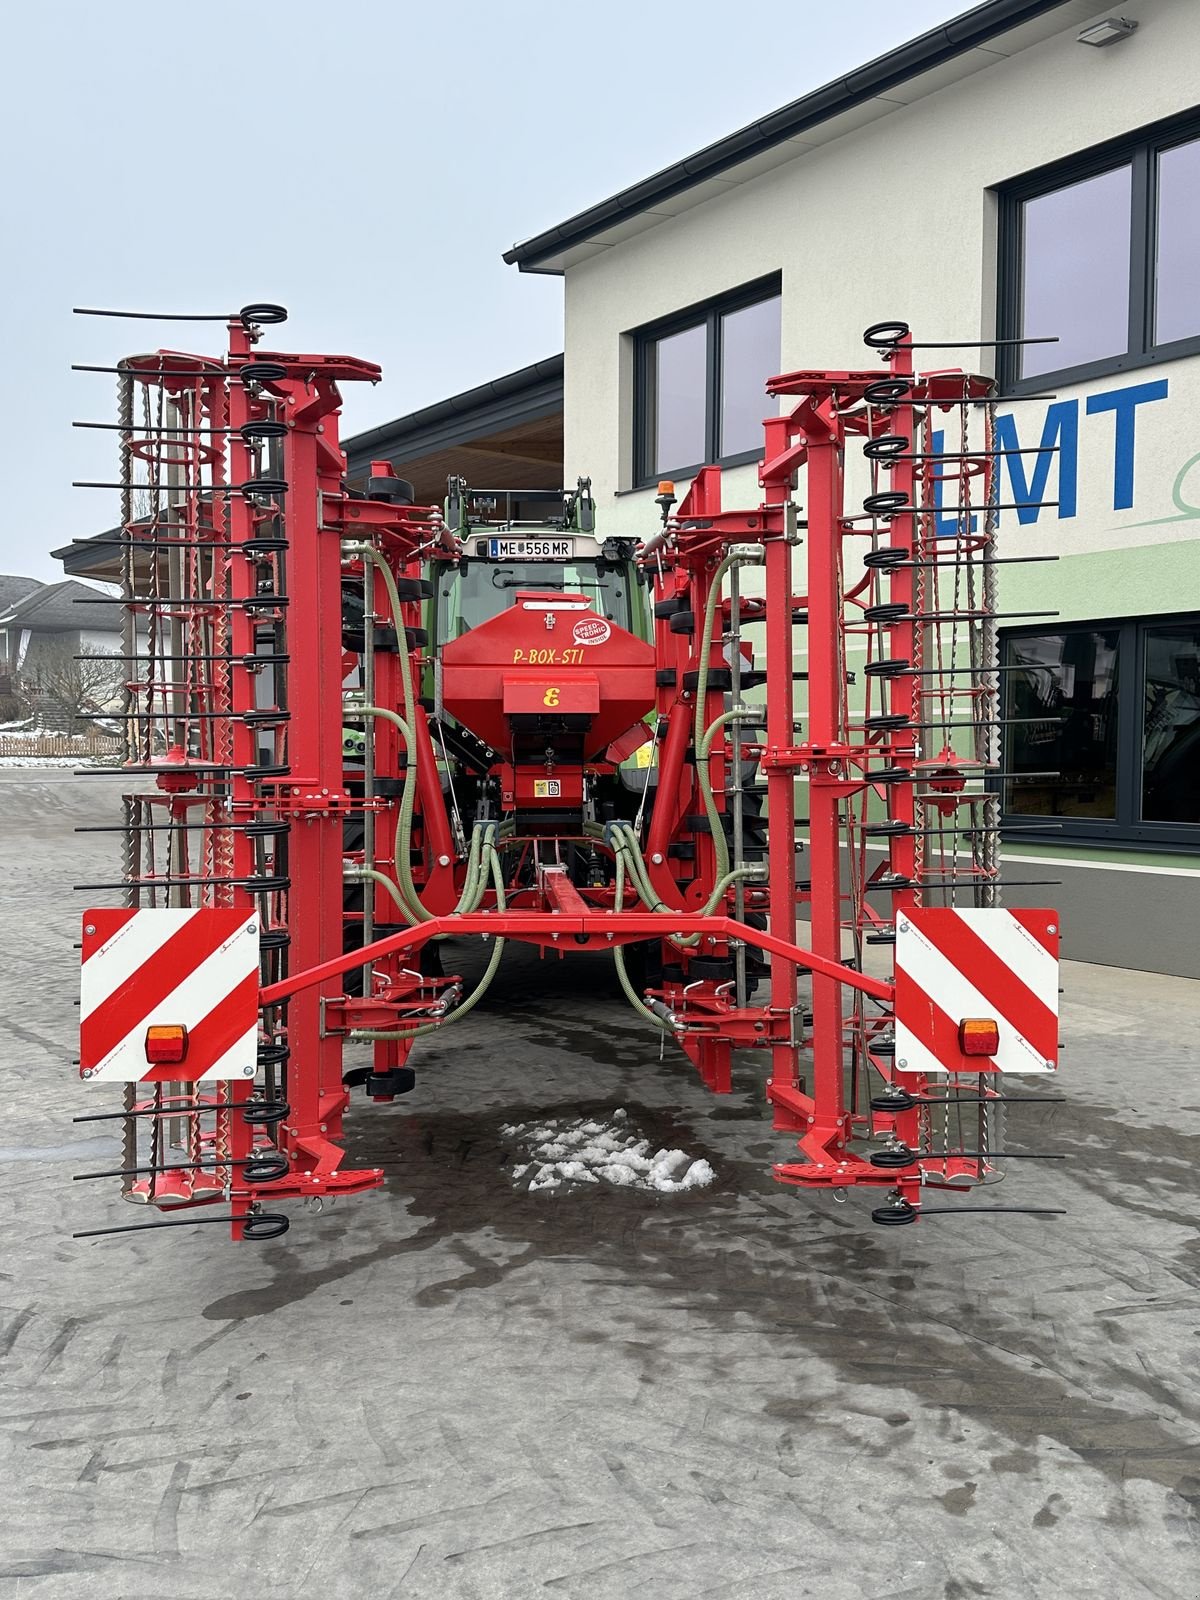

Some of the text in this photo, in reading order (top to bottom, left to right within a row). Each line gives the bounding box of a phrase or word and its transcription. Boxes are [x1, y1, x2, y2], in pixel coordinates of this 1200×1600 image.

[931, 378, 1169, 537] LMT
[500, 542, 569, 555] ME 556 MR
[575, 622, 600, 635] SPEED-
[580, 625, 606, 639] TRONIC
[587, 634, 607, 645] INSIDE
[513, 649, 584, 664] P-BOX-STI
